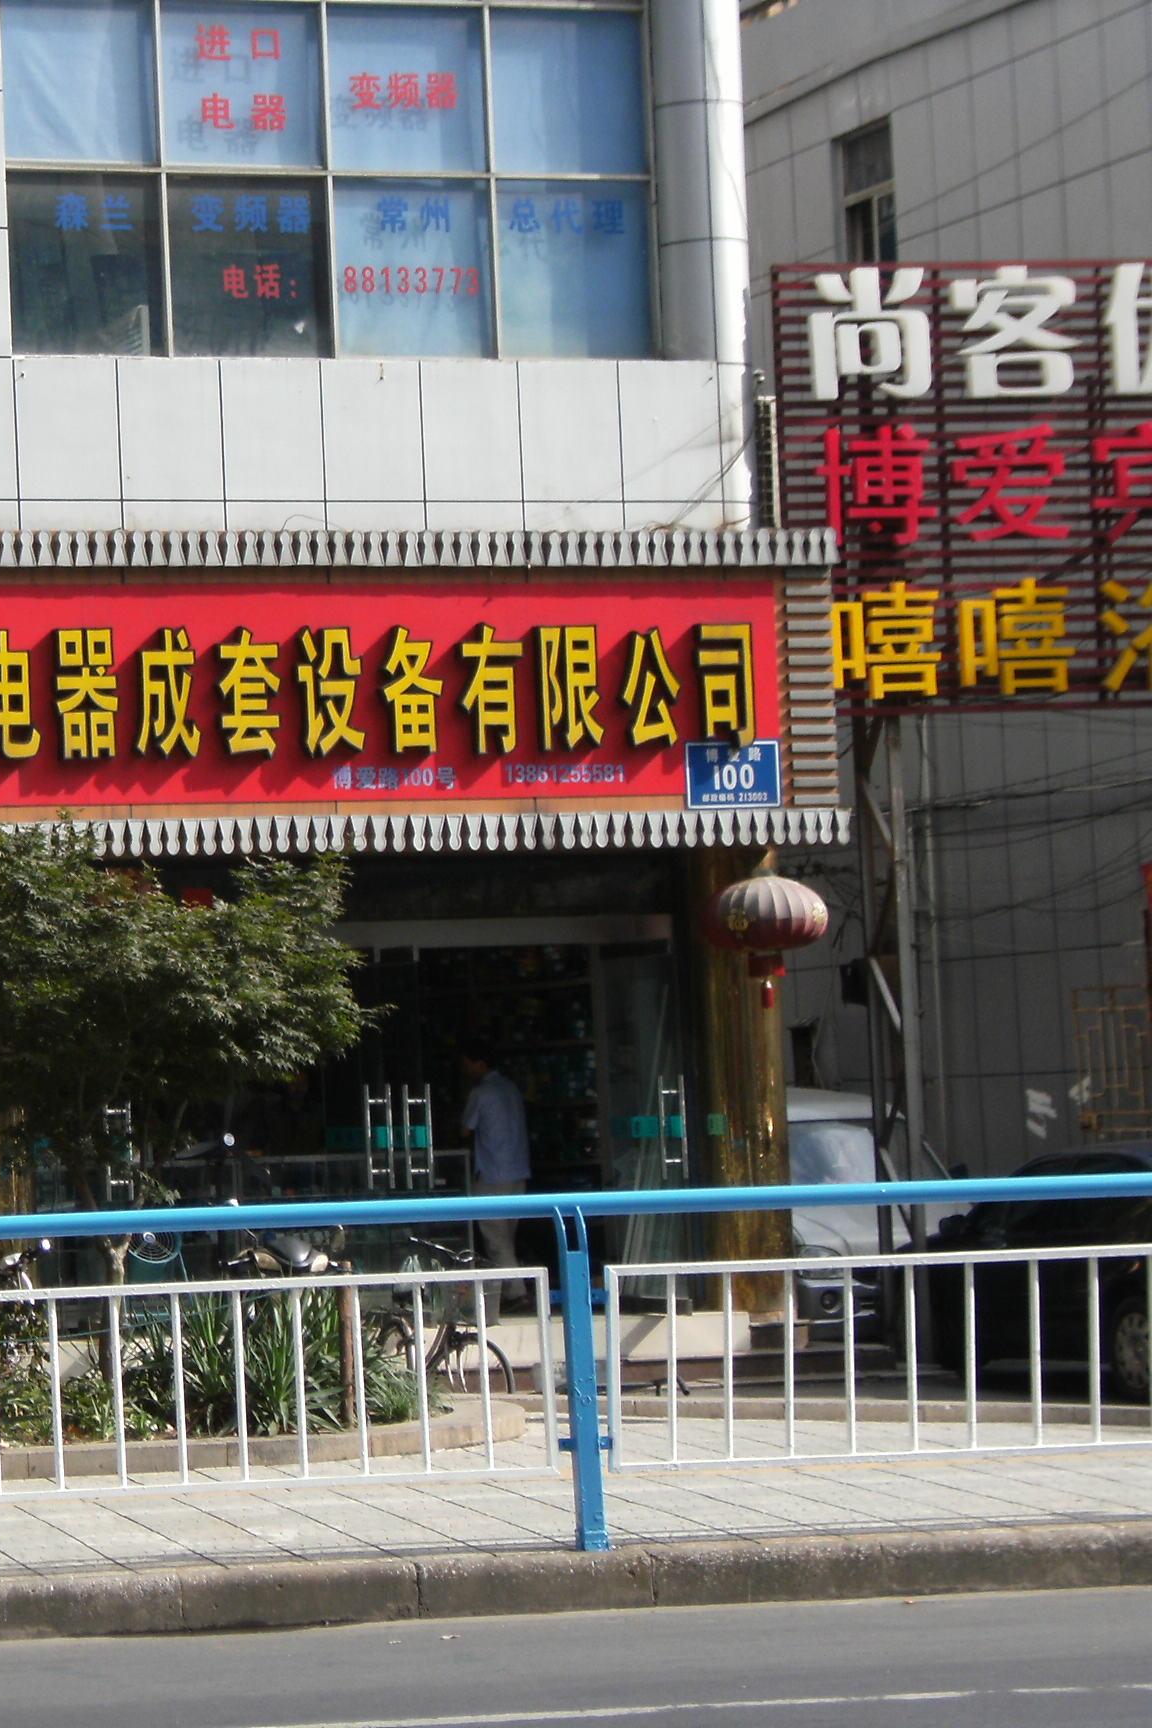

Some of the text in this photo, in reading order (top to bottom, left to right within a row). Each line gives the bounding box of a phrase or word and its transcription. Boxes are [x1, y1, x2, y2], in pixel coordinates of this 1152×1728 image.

[194, 23, 282, 61] 进口
[348, 72, 458, 111] 变频器
[200, 92, 288, 132] 电器
[55, 192, 625, 236] 森兰 变频器 常州 总代理
[344, 265, 480, 296] 88133773
[713, 764, 755, 791] 100
